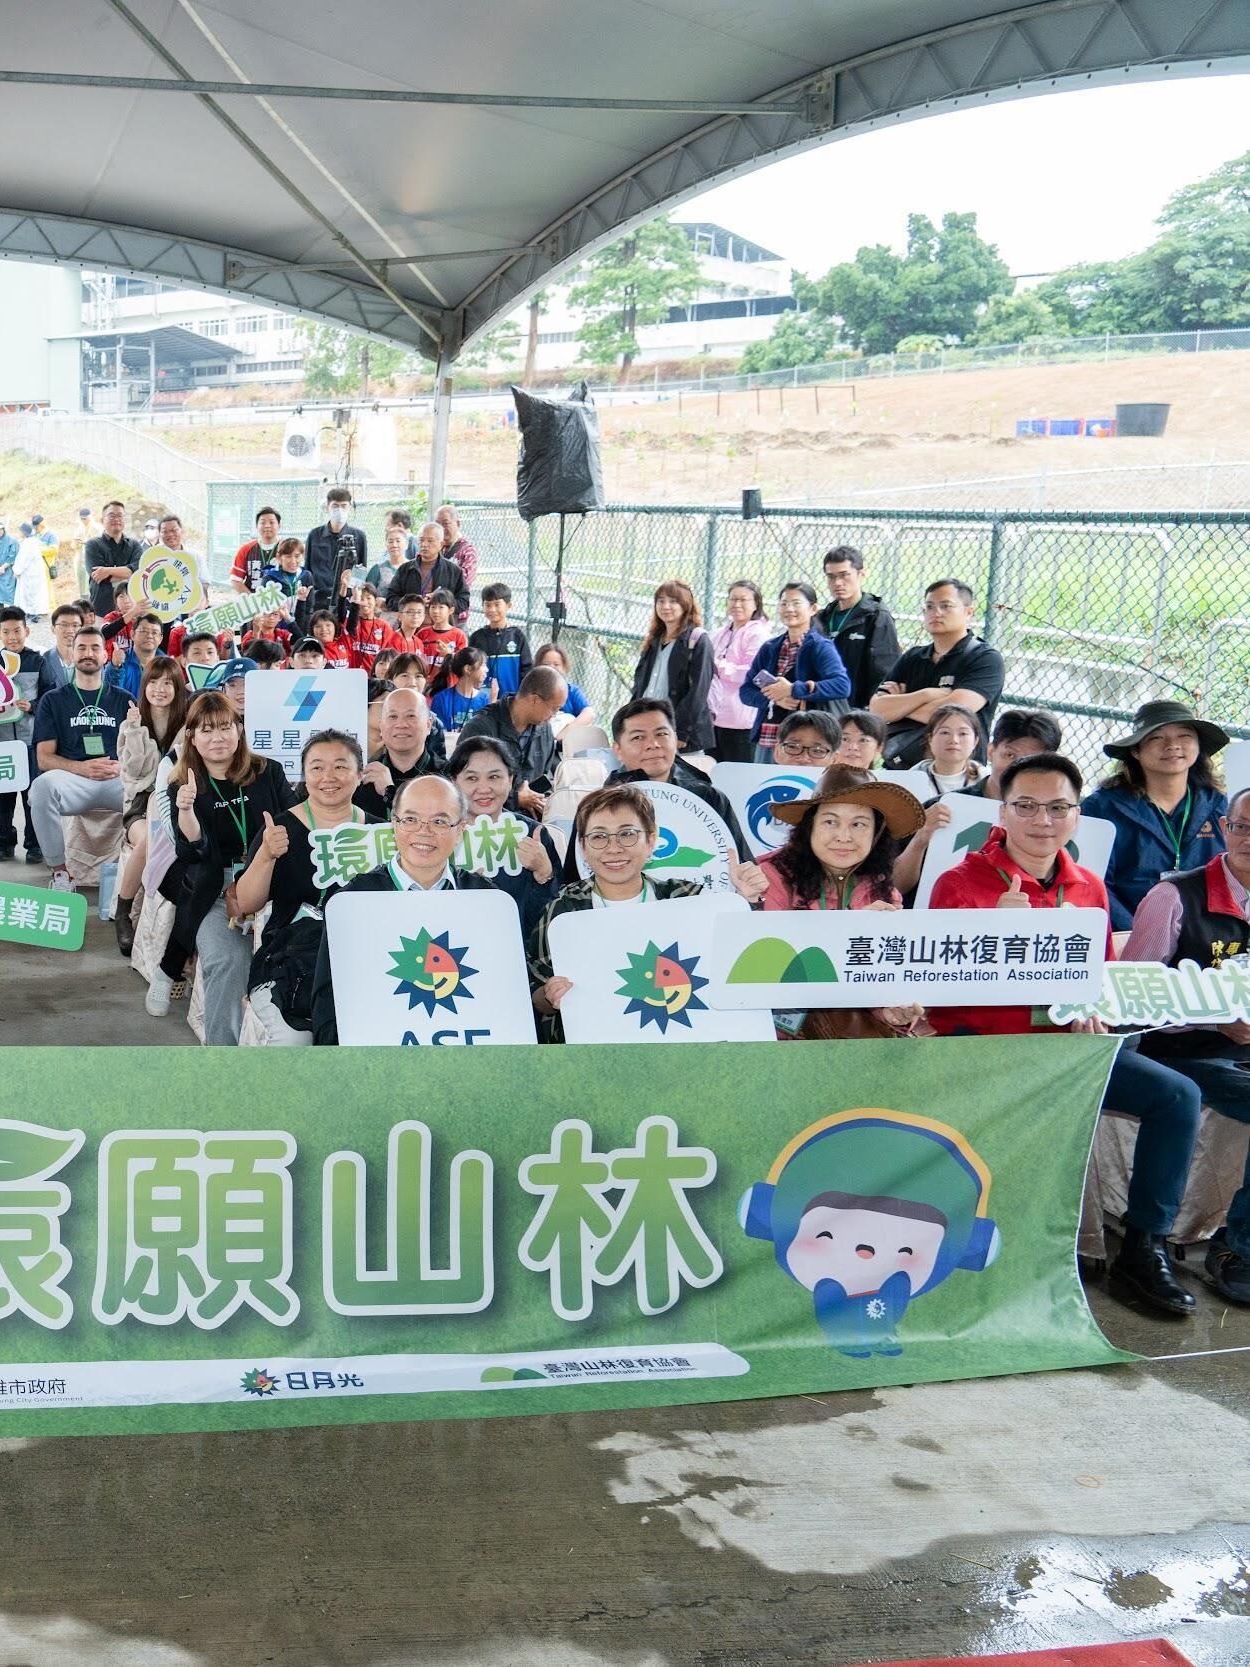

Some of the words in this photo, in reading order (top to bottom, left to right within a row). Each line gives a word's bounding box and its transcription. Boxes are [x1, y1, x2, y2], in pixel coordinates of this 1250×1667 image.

[845, 933, 1092, 966] 臺灣山林復育協會
[844, 970, 895, 983] Taiwan
[903, 969, 999, 982] Reforestation
[1007, 968, 1089, 980] Association
[543, 1357, 692, 1374] 臺灣山林復育協會
[550, 1371, 582, 1379] Taiwan
[585, 1368, 644, 1376] Reforestation
[285, 1371, 364, 1391] 日月光
[16, 1396, 32, 1404] City
